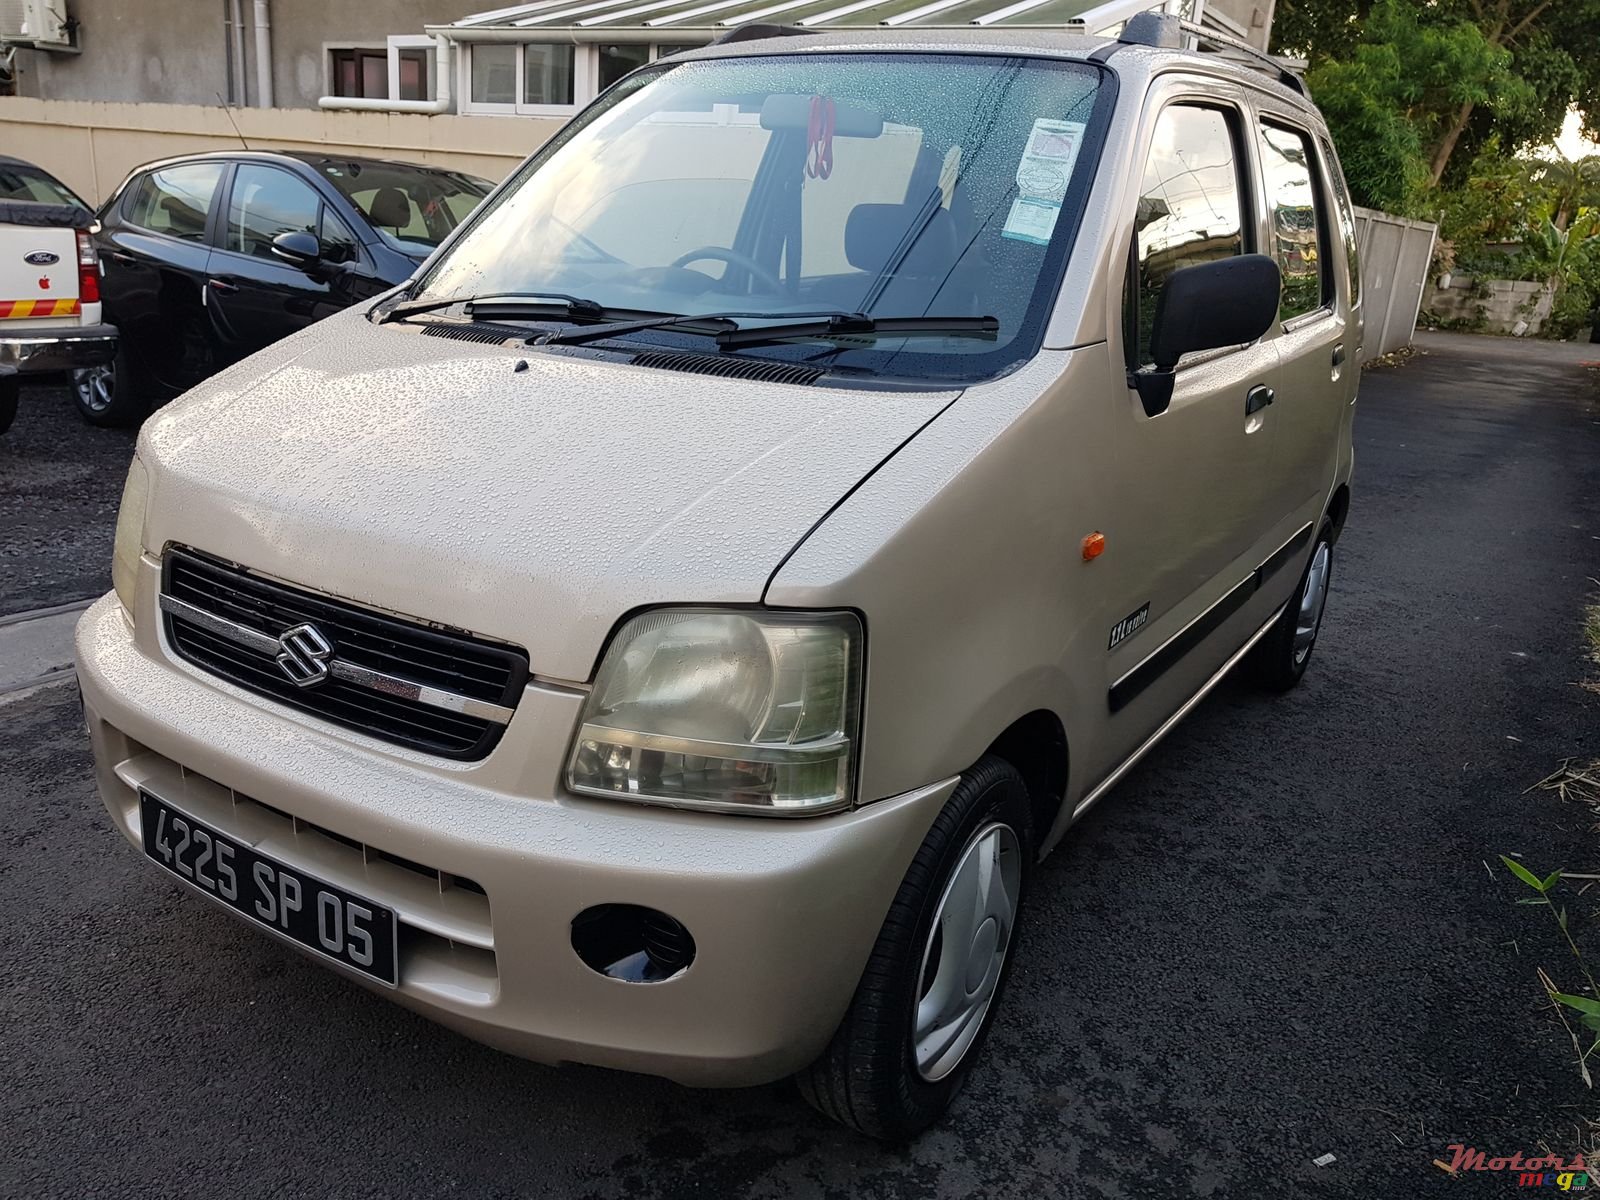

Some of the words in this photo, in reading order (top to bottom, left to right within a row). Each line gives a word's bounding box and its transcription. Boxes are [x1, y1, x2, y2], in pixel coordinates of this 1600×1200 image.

[155, 809, 237, 900] 4225
[253, 861, 302, 928] SP
[317, 890, 373, 966] 05
